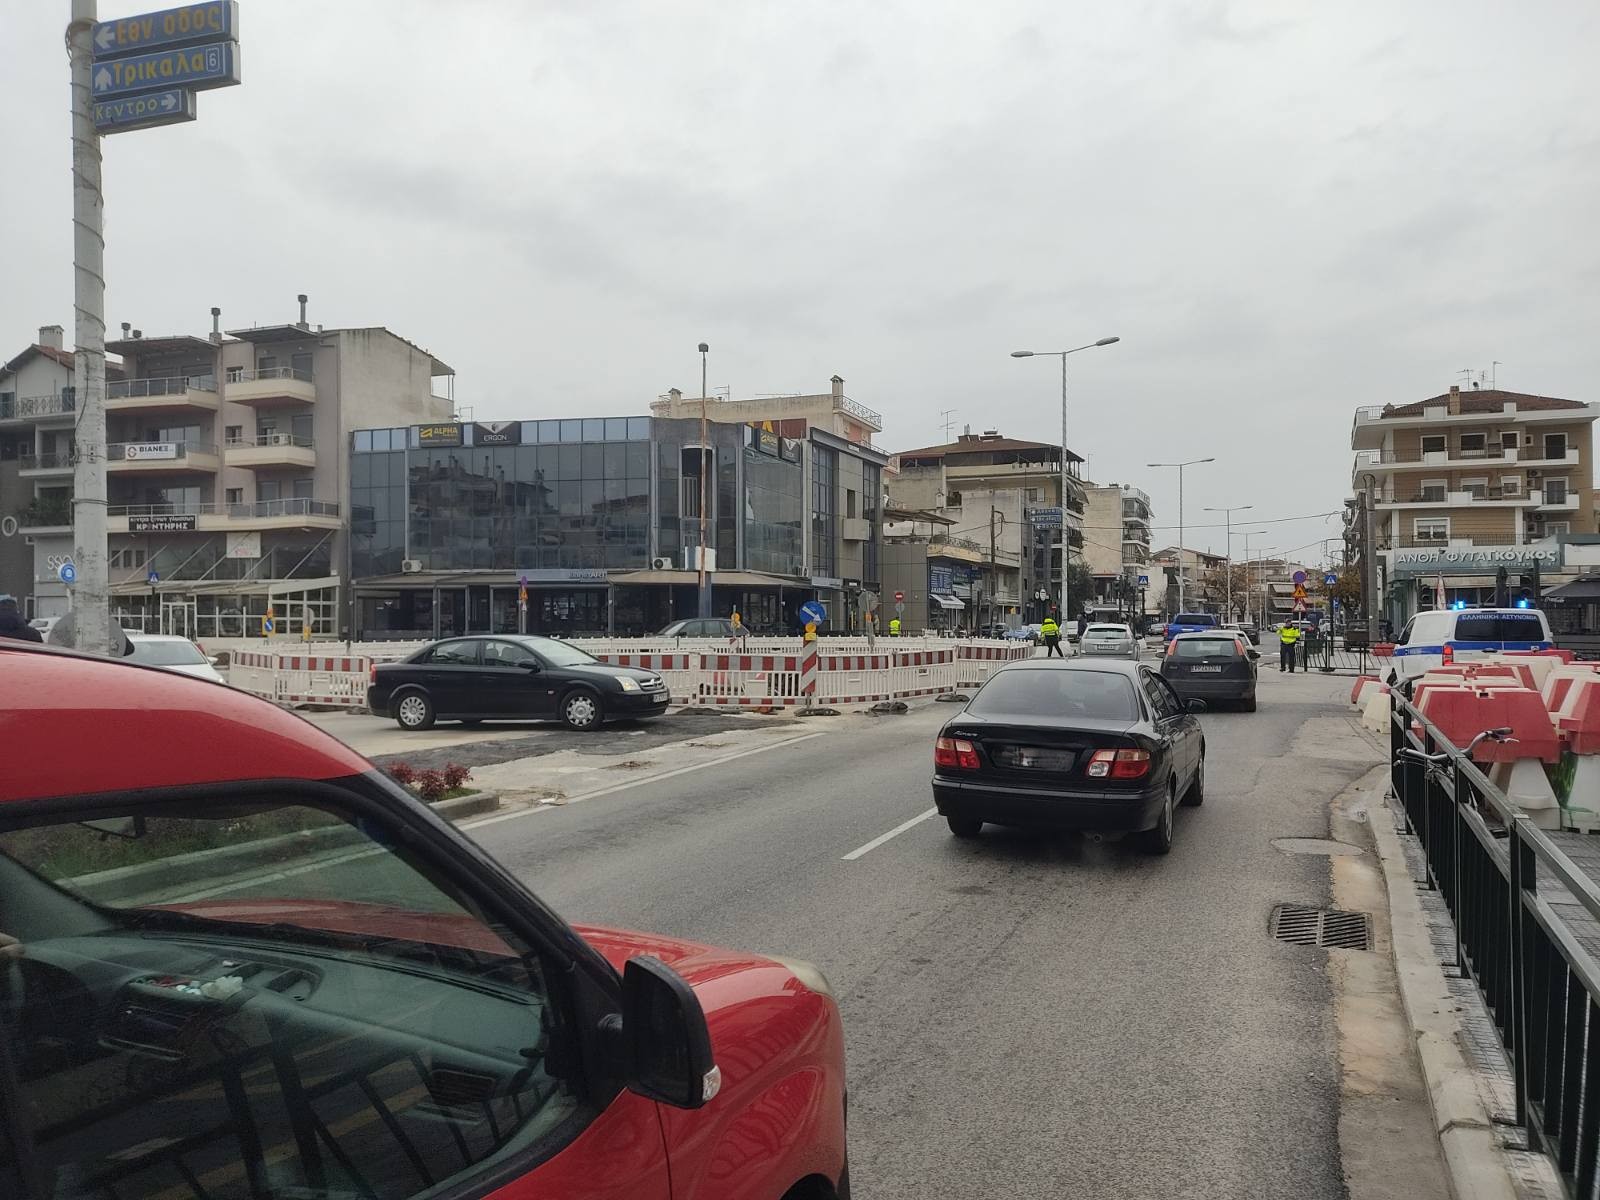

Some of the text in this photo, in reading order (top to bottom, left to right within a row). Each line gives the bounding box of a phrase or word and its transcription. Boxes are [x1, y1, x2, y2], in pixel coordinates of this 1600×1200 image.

[113, 52, 205, 86] Τρικαλα
[1397, 552, 1440, 563] ΑΝΘΗ
[1446, 551, 1488, 562] ΦΥΤΑ
[1461, 613, 1500, 621] ΕΛΛΗΝΙΚΗ
